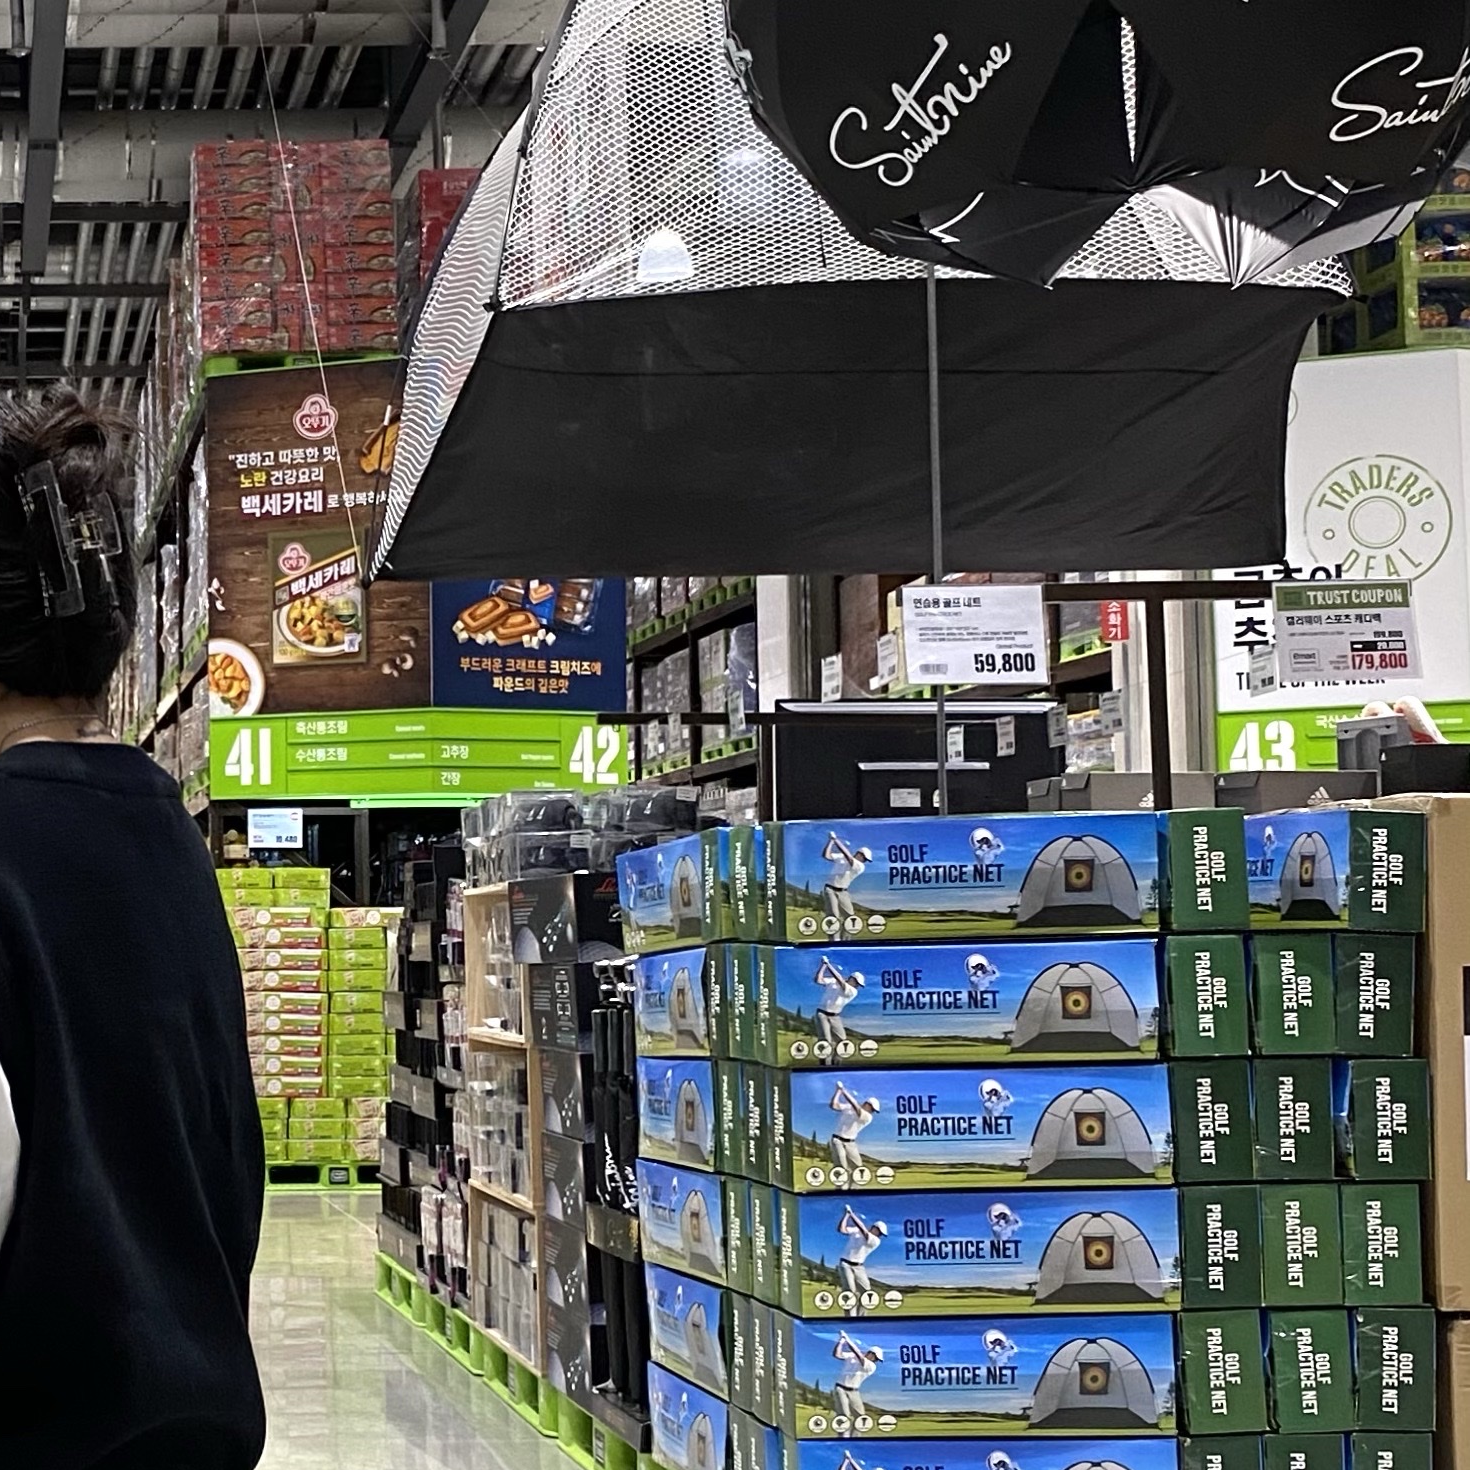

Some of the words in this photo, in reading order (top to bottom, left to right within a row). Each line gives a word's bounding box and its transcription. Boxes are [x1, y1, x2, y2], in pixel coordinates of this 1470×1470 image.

[279, 448, 319, 465] 따뜻한
[240, 472, 267, 488] 노란
[270, 467, 324, 486] 건강요리
[1317, 464, 1435, 511] TRADERS
[241, 490, 323, 518] 백세카레
[327, 494, 339, 509] 로
[290, 556, 356, 595] 백세카레
[943, 597, 961, 608] 골프
[963, 596, 982, 608] 네트
[1307, 590, 1351, 605] TRUST
[1351, 588, 1403, 604] COUPON
[1107, 601, 1122, 640] 소화기
[1325, 614, 1352, 624] 스포츠
[460, 657, 503, 673] 부드러운
[505, 658, 547, 673] 크래프트
[549, 659, 602, 676] 크림치즈에
[974, 652, 1036, 674] 59,800
[1351, 653, 1408, 671] 179,800
[493, 676, 536, 693] 파운드의
[537, 678, 569, 695] 깊은맛
[225, 727, 272, 786] 41
[295, 747, 348, 763] 수산통조림
[440, 744, 469, 760] 고추장
[569, 725, 620, 784] 42
[1230, 720, 1297, 771] 43
[440, 771, 461, 786] 간장
[888, 844, 928, 863] GOLF
[1193, 826, 1211, 886] PRACTICE
[1372, 828, 1388, 887] PRACTICE
[889, 865, 968, 885] PRACTICE
[973, 863, 1005, 882] NET
[1210, 851, 1226, 882] GOLF
[1389, 854, 1403, 885] GOLF
[1196, 888, 1212, 912] NET
[1371, 889, 1387, 914] NET
[881, 970, 921, 988] GOLF
[1279, 951, 1297, 1010] PRACTICE
[882, 991, 963, 1010] PRACTICE
[968, 990, 1000, 1008] NET
[1297, 976, 1312, 1007] GOLF
[1284, 1012, 1299, 1037] NET
[896, 1095, 936, 1114] GOLF
[1196, 1078, 1214, 1138] PRACTICE
[897, 1117, 977, 1136] PRACTICE
[982, 1116, 1014, 1134] NET
[1214, 1103, 1230, 1135] GOLF
[1200, 1140, 1216, 1165] NET
[903, 1219, 944, 1238] GOLF
[904, 1241, 985, 1260] PRACTICE
[989, 1240, 1021, 1258] NET
[899, 1345, 940, 1363] GOLF
[1296, 1328, 1316, 1388] PRACTICE
[901, 1367, 981, 1386] PRACTICE
[986, 1366, 1019, 1384] NET
[1315, 1353, 1332, 1384] GOLF
[1301, 1390, 1318, 1415] NET
